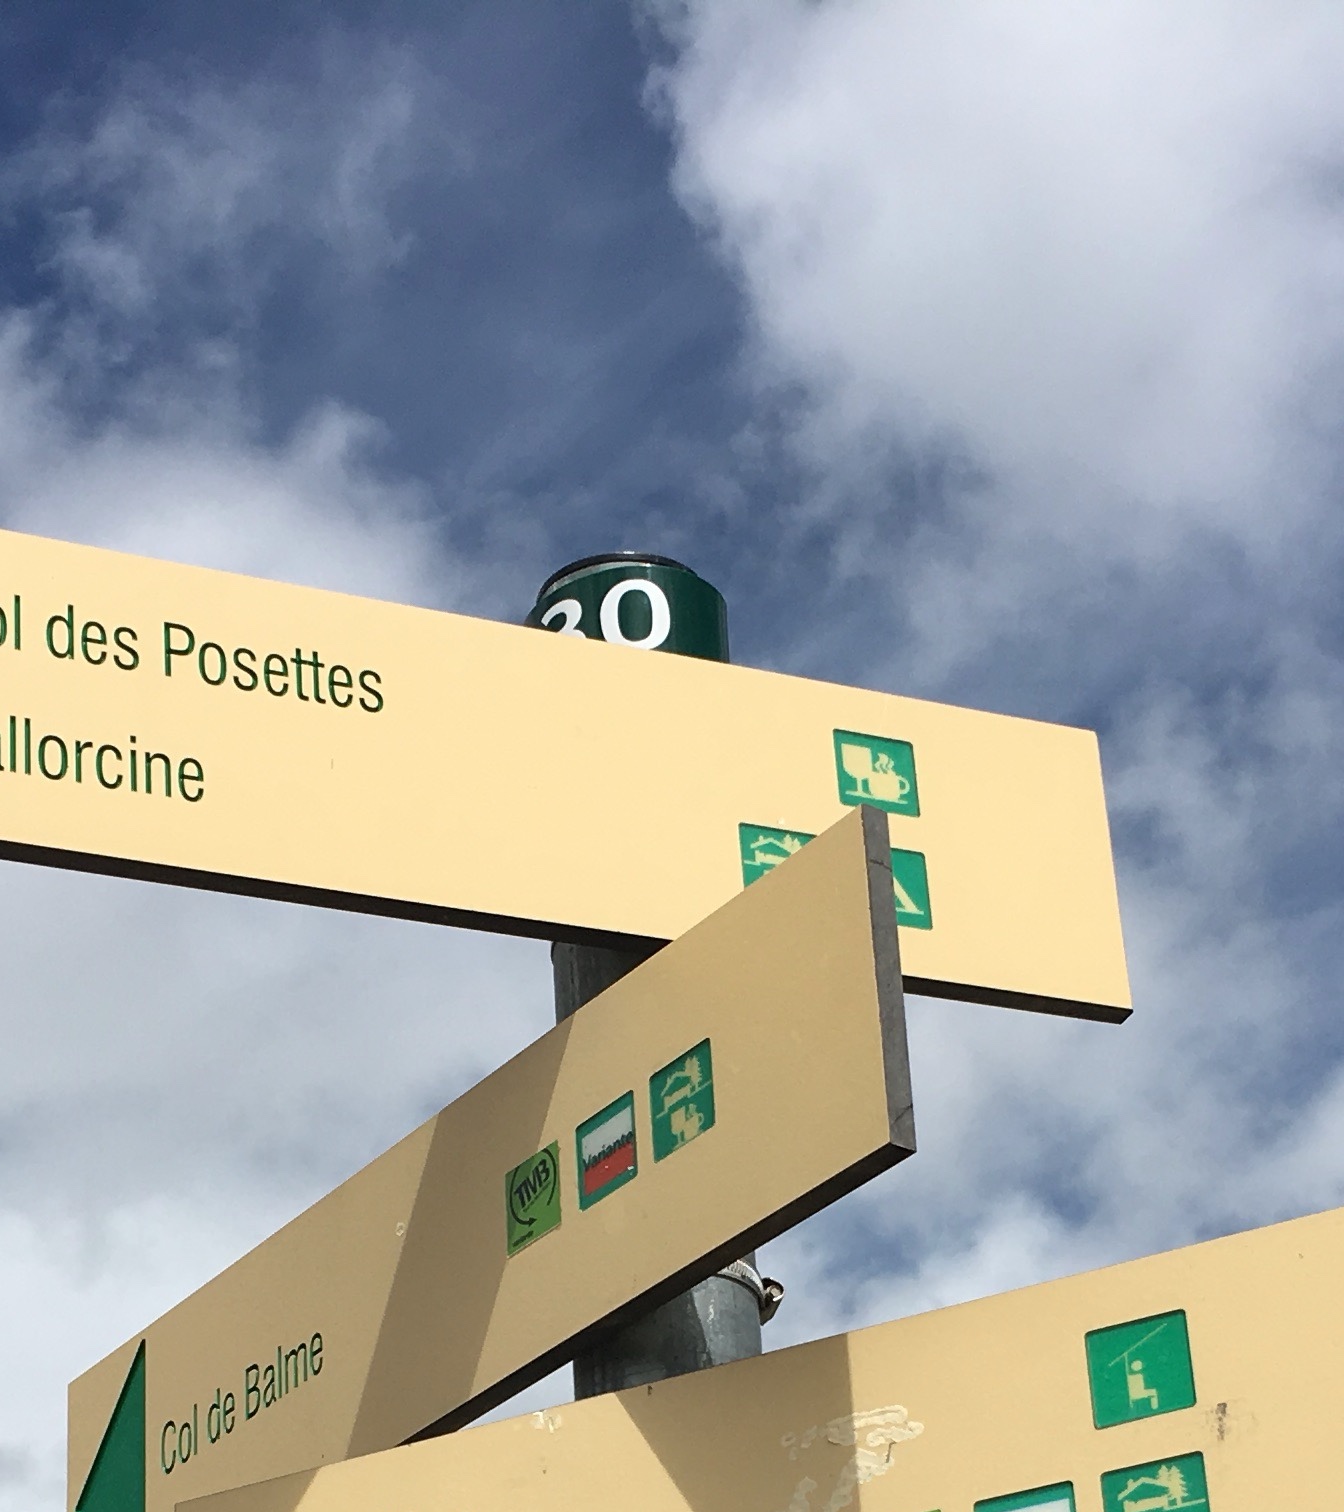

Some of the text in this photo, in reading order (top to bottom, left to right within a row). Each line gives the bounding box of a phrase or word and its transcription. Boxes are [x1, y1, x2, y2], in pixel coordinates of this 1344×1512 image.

[46, 604, 141, 671] des
[163, 621, 385, 713] Posettes
[513, 1158, 551, 1208] TMB
[159, 1331, 325, 1475] Col de Balme
